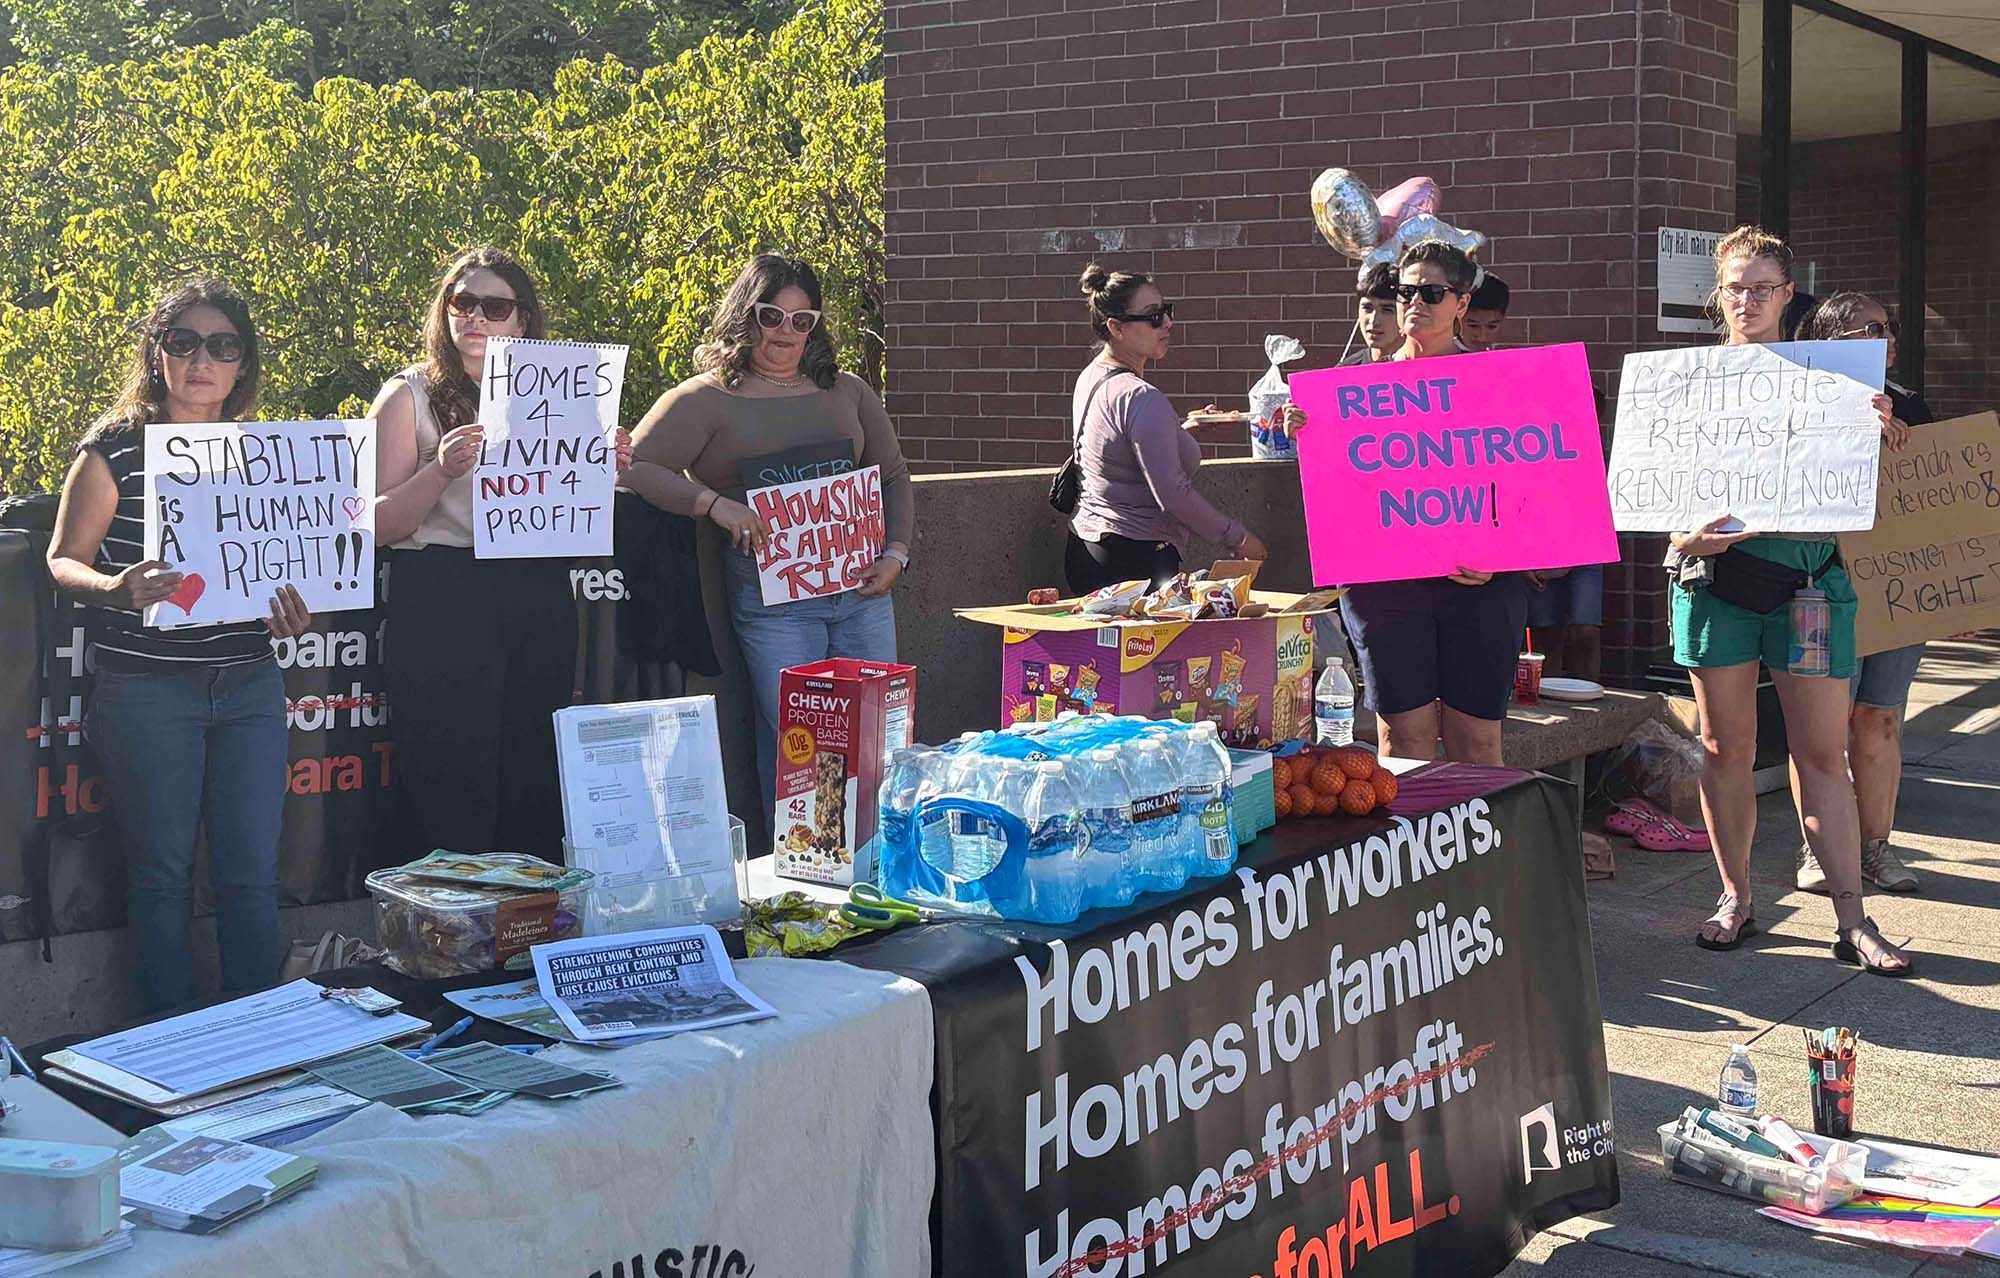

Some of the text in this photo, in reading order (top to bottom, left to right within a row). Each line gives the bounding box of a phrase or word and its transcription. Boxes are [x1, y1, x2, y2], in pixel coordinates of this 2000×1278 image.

[1660, 229, 1674, 259] City
[1675, 231, 1689, 255] Hall
[1690, 232, 1707, 257] main
[489, 354, 613, 402] HOMES
[1336, 377, 1457, 420] RENT
[526, 399, 565, 437] 4
[166, 434, 367, 489] STABILITY
[479, 436, 609, 468] LIVING
[1349, 422, 1578, 472] CONTROL
[1880, 439, 1992, 487] vienda es
[480, 470, 582, 501] NOT 4
[1610, 467, 1689, 512] RENT
[215, 493, 335, 533] HUMAN
[752, 470, 881, 535] HOUSING
[1379, 481, 1500, 529] NOW!
[486, 504, 601, 543] PROFIT
[159, 524, 185, 563] A
[759, 532, 791, 573] IS
[797, 528, 817, 559] A
[1958, 537, 1986, 561] IS
[569, 568, 632, 601] res.
[775, 552, 875, 600] RIGH
[1884, 574, 1985, 622] RIGHT
[1278, 634, 1311, 660] elVita
[805, 680, 833, 689] KIRKLAND
[860, 667, 888, 676] KIRKLAND
[788, 692, 851, 713] CHEWY
[884, 687, 911, 703] CHEWY
[788, 708, 849, 729] PROTEIN
[816, 727, 849, 742] BARS
[787, 732, 809, 752] 10g
[787, 811, 807, 821] BARS
[788, 798, 807, 813] 42
[1132, 792, 1180, 815] KIRKLAN
[502, 925, 549, 940] Madeleines
[1013, 797, 1502, 1053] Homes for workers.
[551, 938, 702, 971] STRENGTHENING COMMUNITIES
[555, 951, 702, 985] THROUGH RENT CONTROL AND
[558, 979, 620, 997] JUST-CAUSE
[621, 969, 678, 988] EVICTIONS:
[1024, 902, 1504, 1192] Homes for families.
[1024, 1018, 1478, 1278] Homes for profit.
[1563, 1119, 1612, 1146] Right to
[1566, 1137, 1615, 1165] the City
[1349, 1147, 1462, 1271] ALL.
